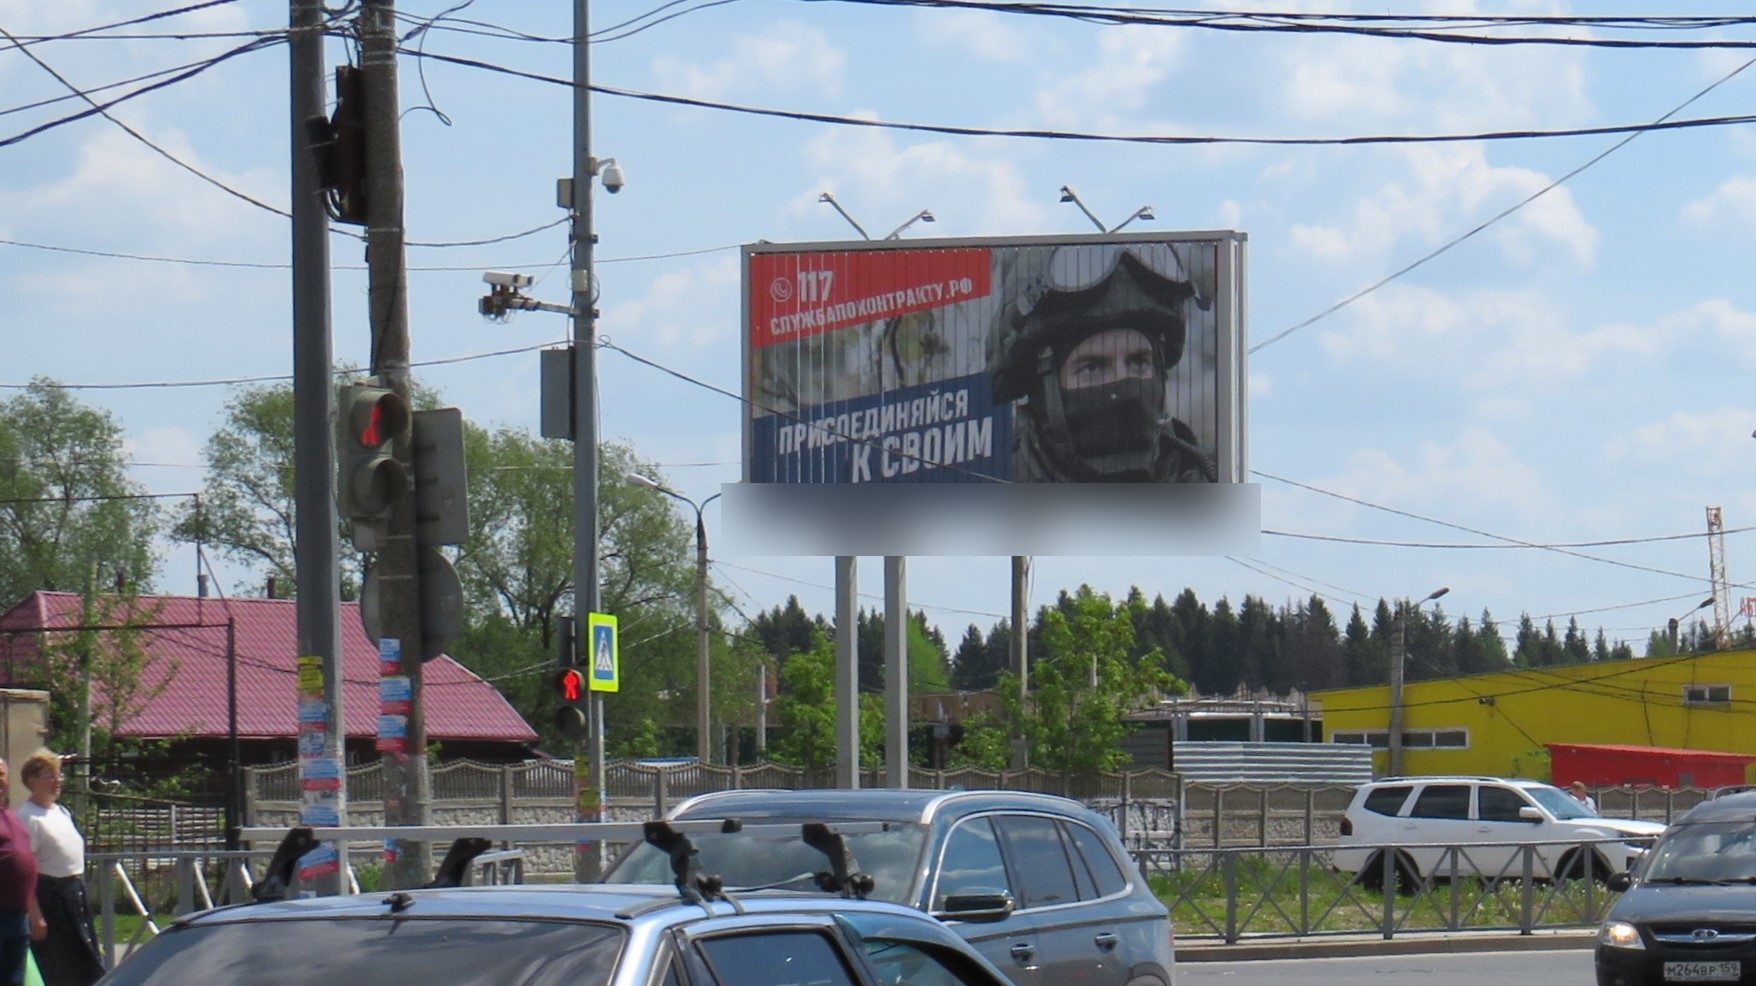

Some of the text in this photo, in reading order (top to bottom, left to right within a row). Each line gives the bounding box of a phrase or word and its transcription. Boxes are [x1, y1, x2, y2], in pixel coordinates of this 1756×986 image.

[769, 277, 972, 335] СЛУЖБАПОКОНТРАКТУ.РФ
[798, 271, 834, 301] 117
[779, 389, 968, 455] ПРИСОЕДИНЯЙСЯ
[852, 416, 993, 483] К СВОИМ
